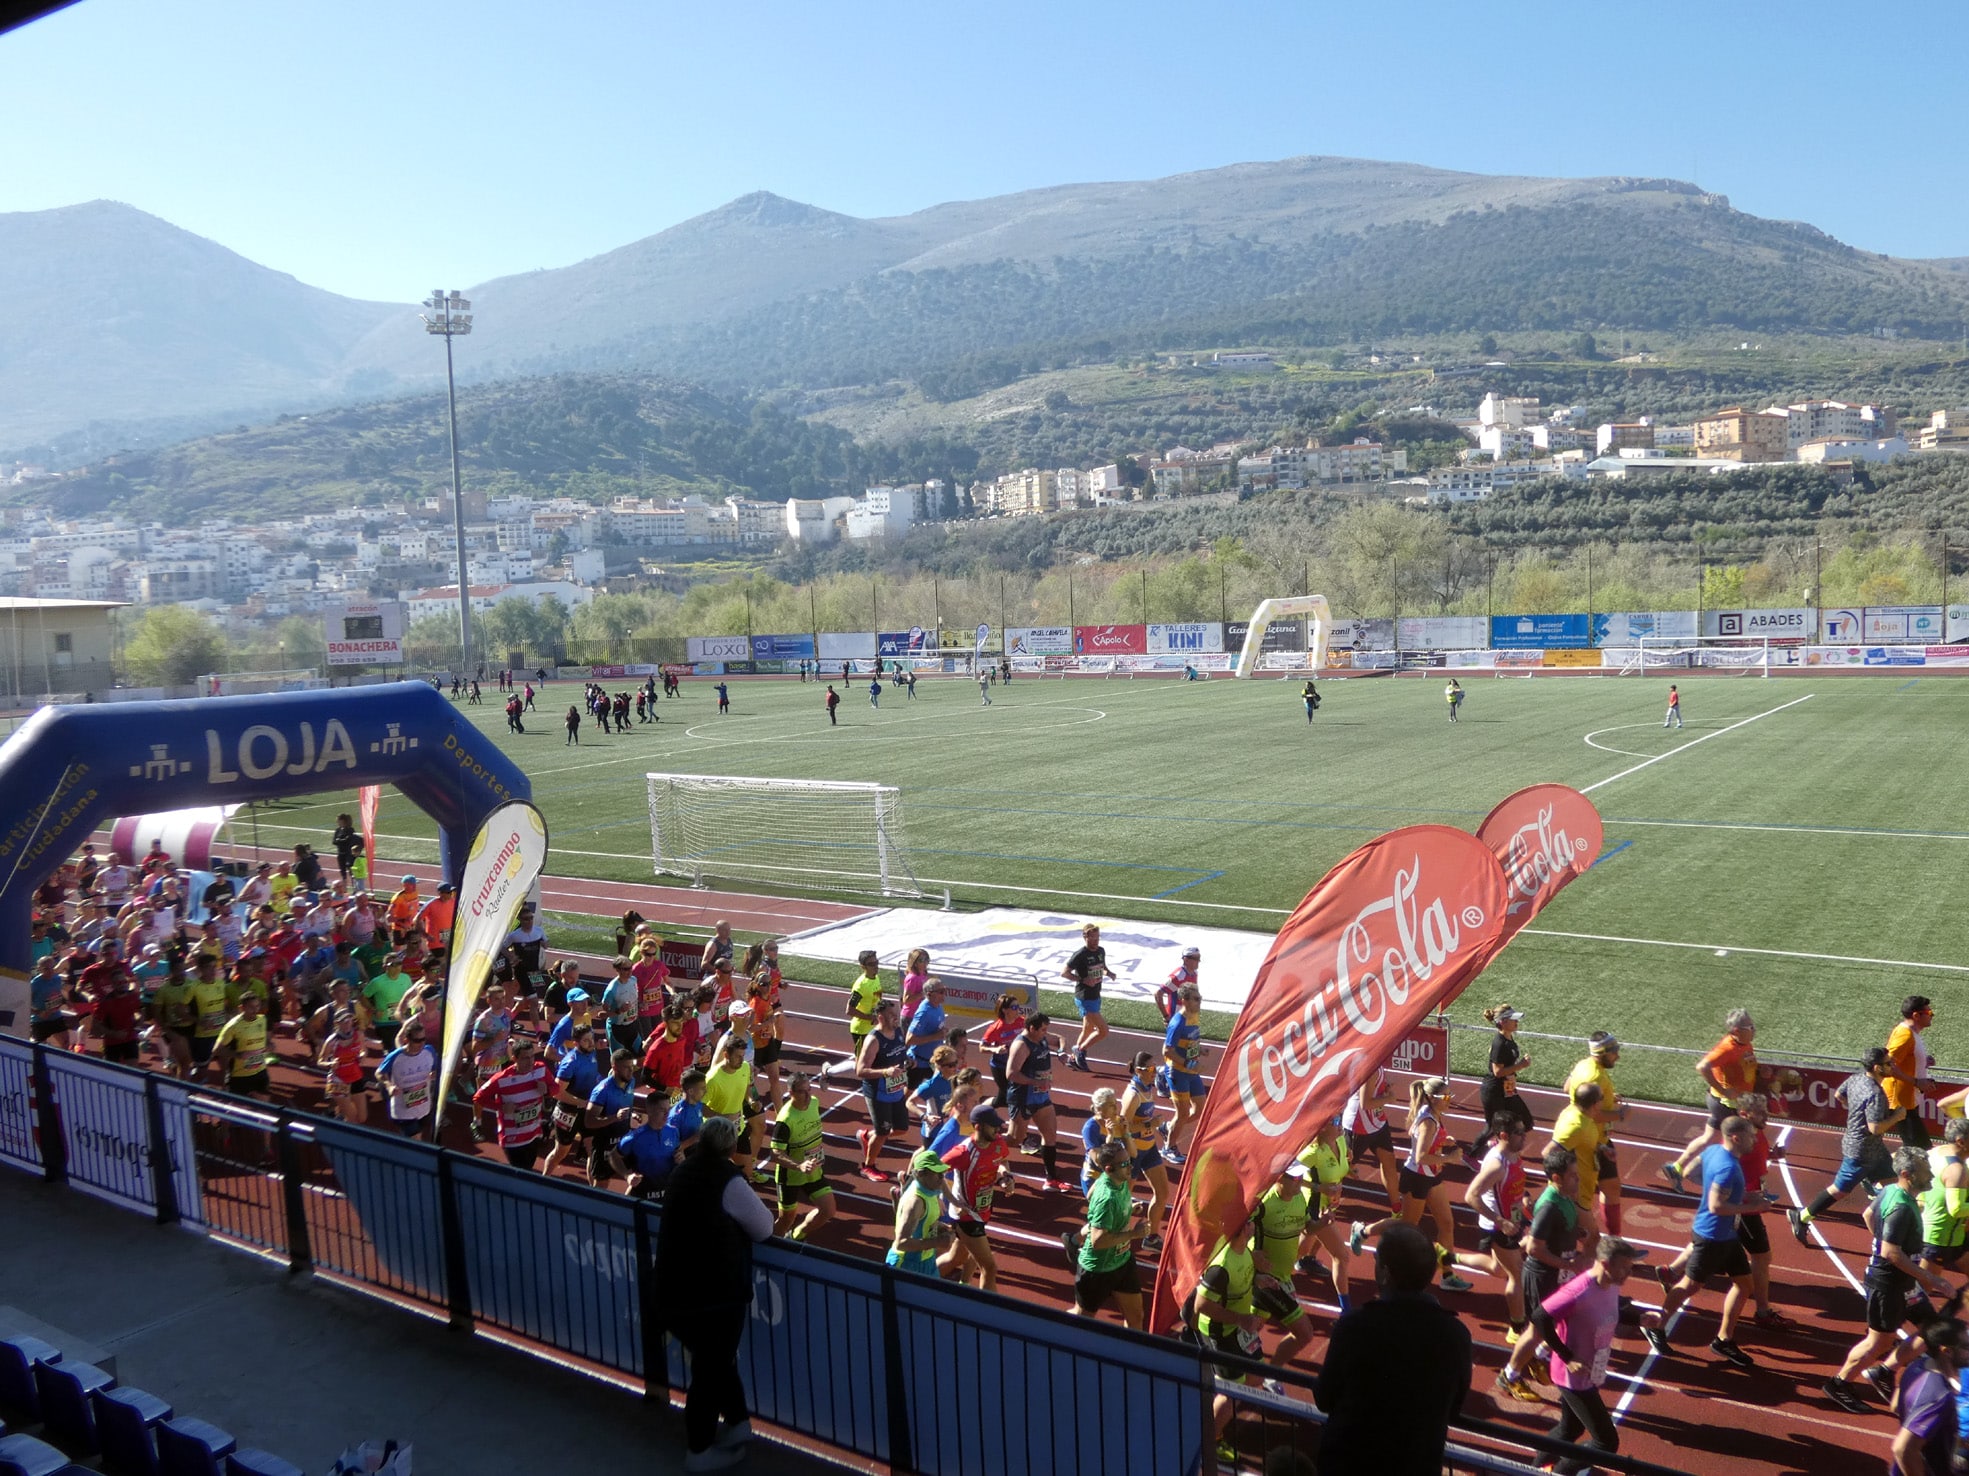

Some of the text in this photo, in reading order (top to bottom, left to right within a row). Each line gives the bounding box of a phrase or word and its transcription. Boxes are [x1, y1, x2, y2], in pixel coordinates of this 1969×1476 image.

[1749, 614, 1803, 626] ABADES
[1165, 624, 1207, 632] TALLERES
[879, 640, 898, 652] AXA
[1100, 636, 1121, 645] Apolo
[1168, 633, 1203, 649] KINI
[328, 641, 398, 653] BONACHERA
[702, 640, 746, 656] Loxa
[205, 717, 358, 785] LOJA
[443, 732, 512, 801] Deportes
[17, 788, 98, 871] Ciudadana
[471, 831, 521, 917] Cruzcampo
[485, 878, 511, 920] Radler
[1393, 1059, 1410, 1070] SIN
[519, 1109, 538, 1121] 779
[646, 1190, 666, 1199] LAST
